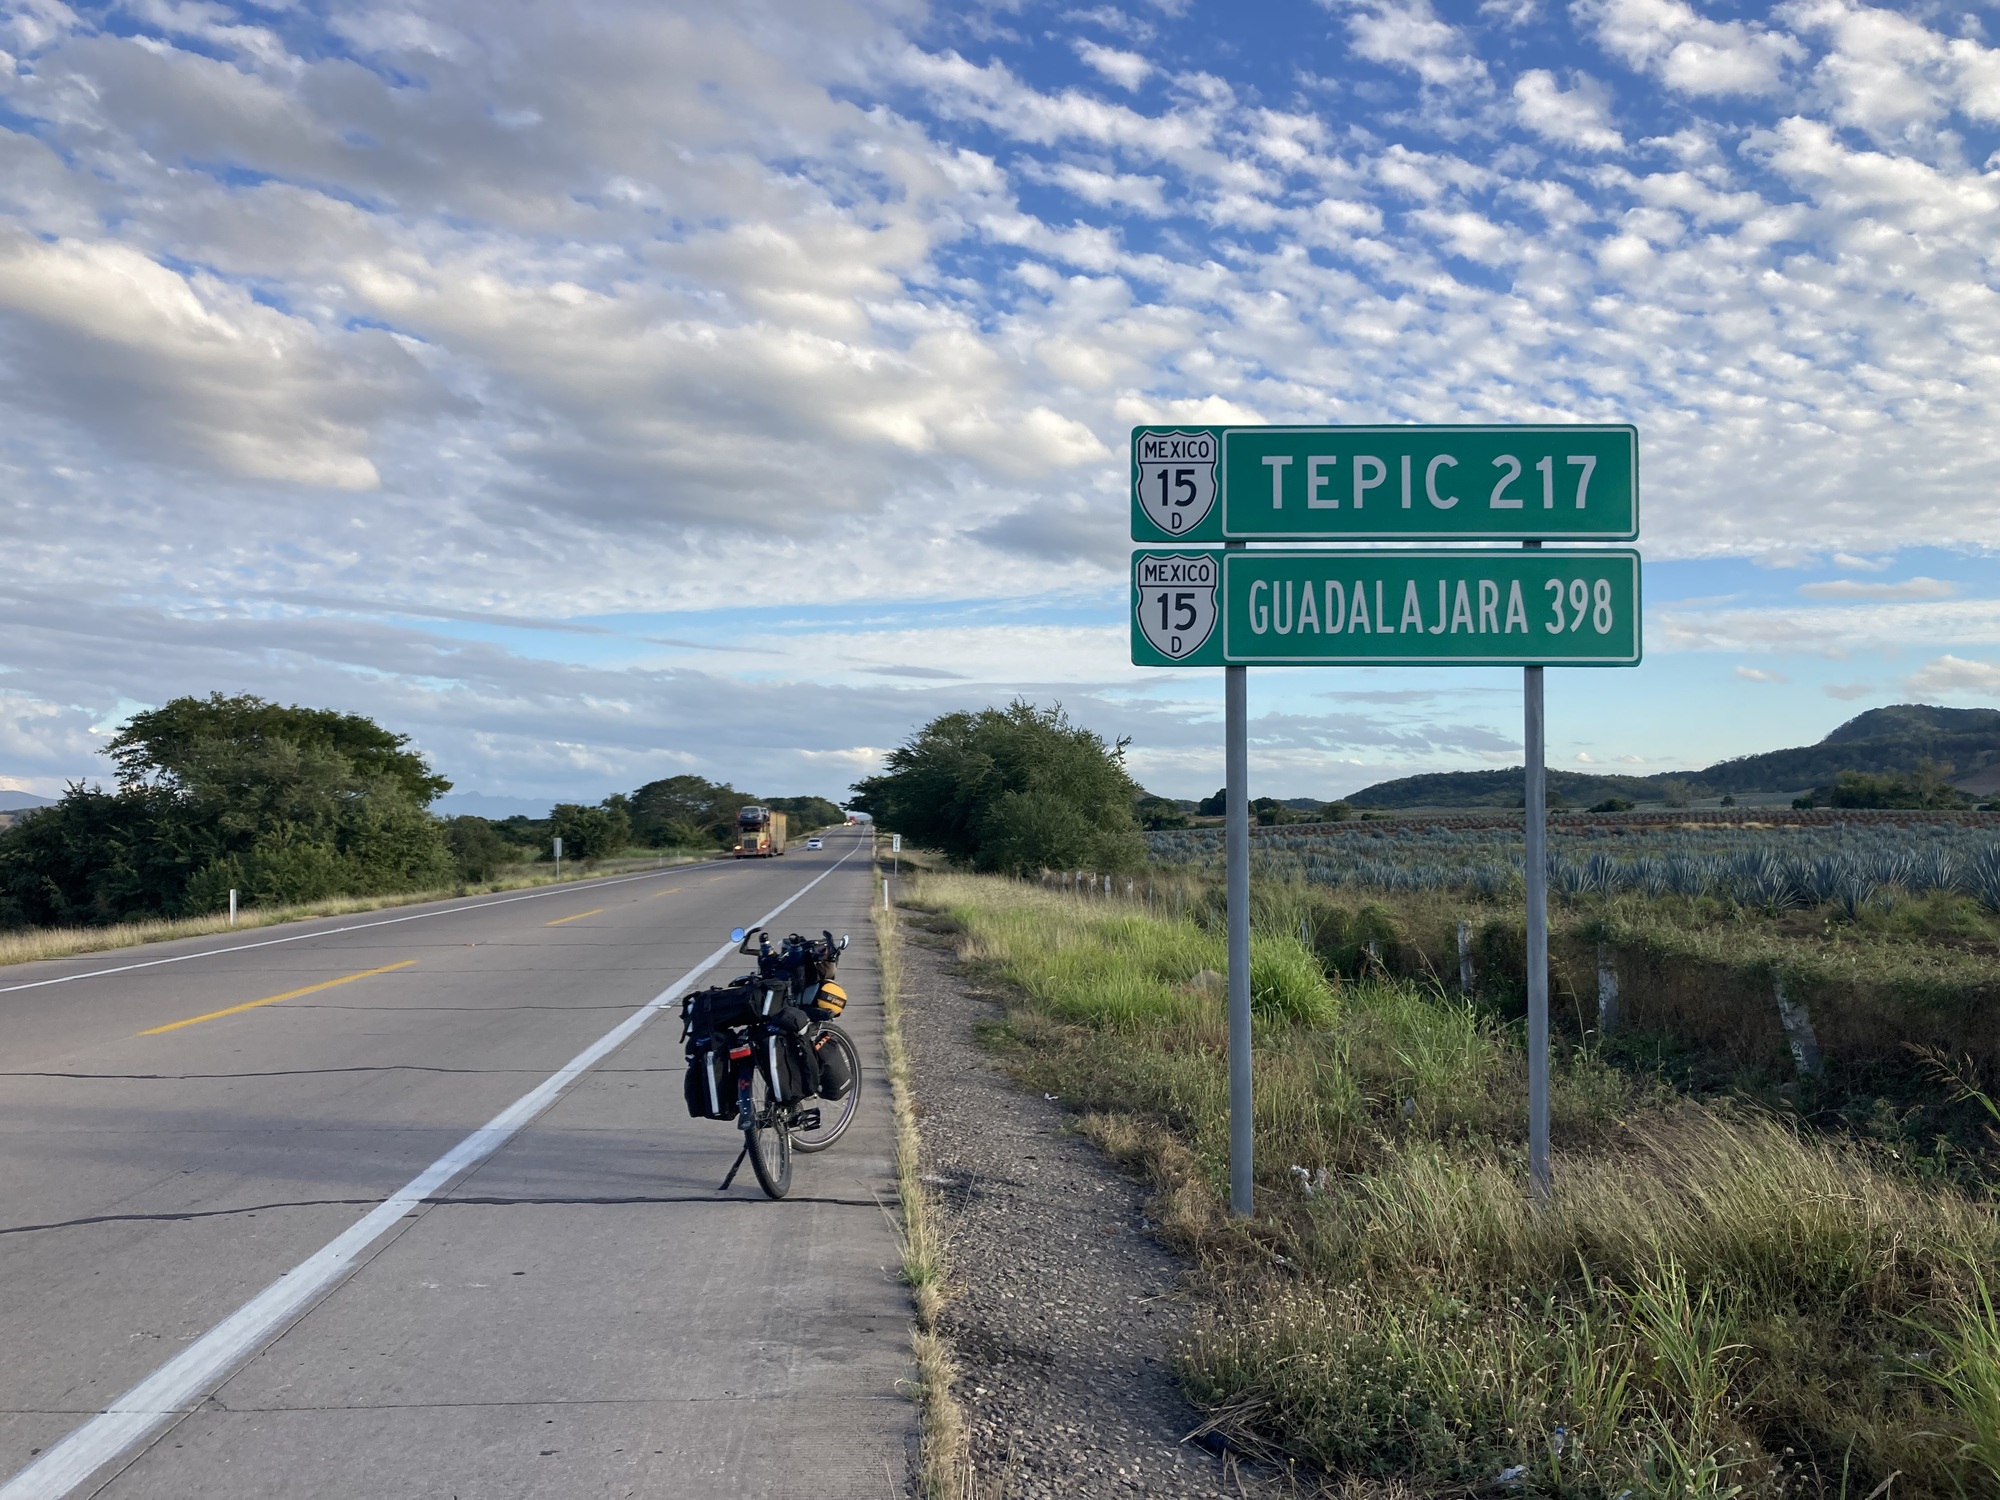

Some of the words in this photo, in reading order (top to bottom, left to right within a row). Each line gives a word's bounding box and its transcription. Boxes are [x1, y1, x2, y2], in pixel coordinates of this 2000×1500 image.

[1144, 441, 1209, 458] MEXICO
[1157, 469, 1197, 507] 15
[1261, 454, 1459, 509] TEPIC
[1489, 454, 1597, 509] 217
[1171, 512, 1183, 529] D
[1144, 564, 1209, 582] MEXICO
[1157, 593, 1197, 631] 15
[1249, 579, 1529, 635] GUADALAJARA
[1544, 579, 1613, 635] 398
[1171, 636, 1182, 653] D
